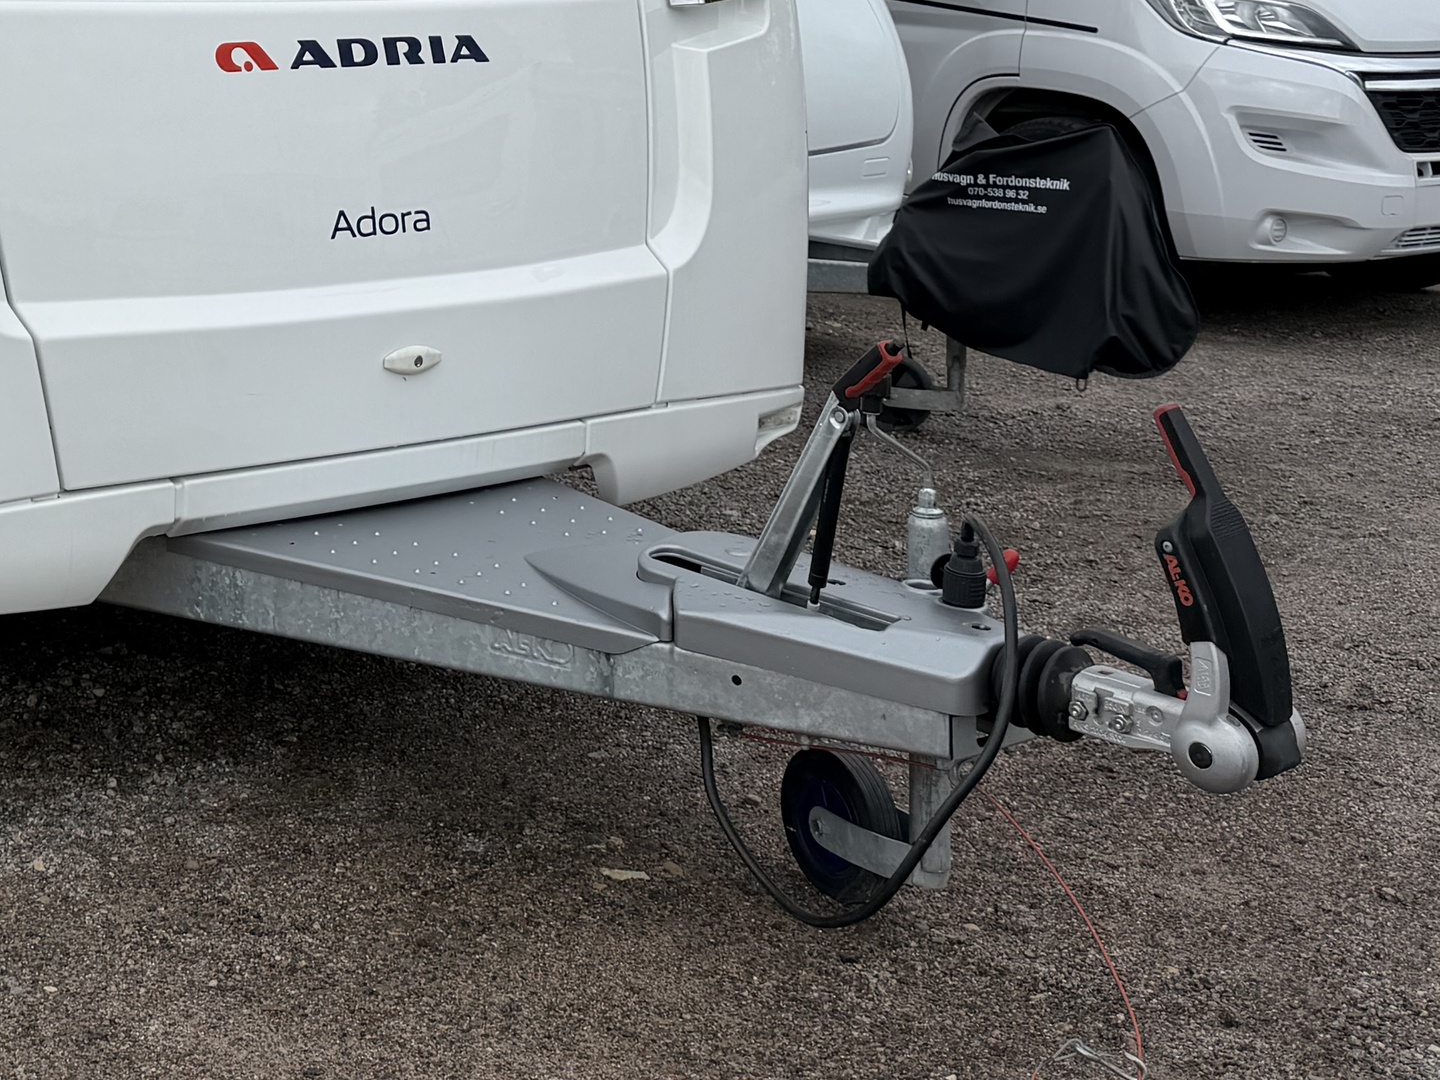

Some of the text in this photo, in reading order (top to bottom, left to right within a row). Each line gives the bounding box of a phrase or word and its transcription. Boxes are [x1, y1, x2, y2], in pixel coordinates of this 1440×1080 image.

[290, 35, 490, 70] ADRIA
[967, 186, 1029, 200] 070-538 96 32
[976, 174, 987, 185] &
[989, 174, 1071, 191] Fordonsteknik
[330, 206, 431, 240] Adora
[1162, 553, 1194, 607] AL-KO
